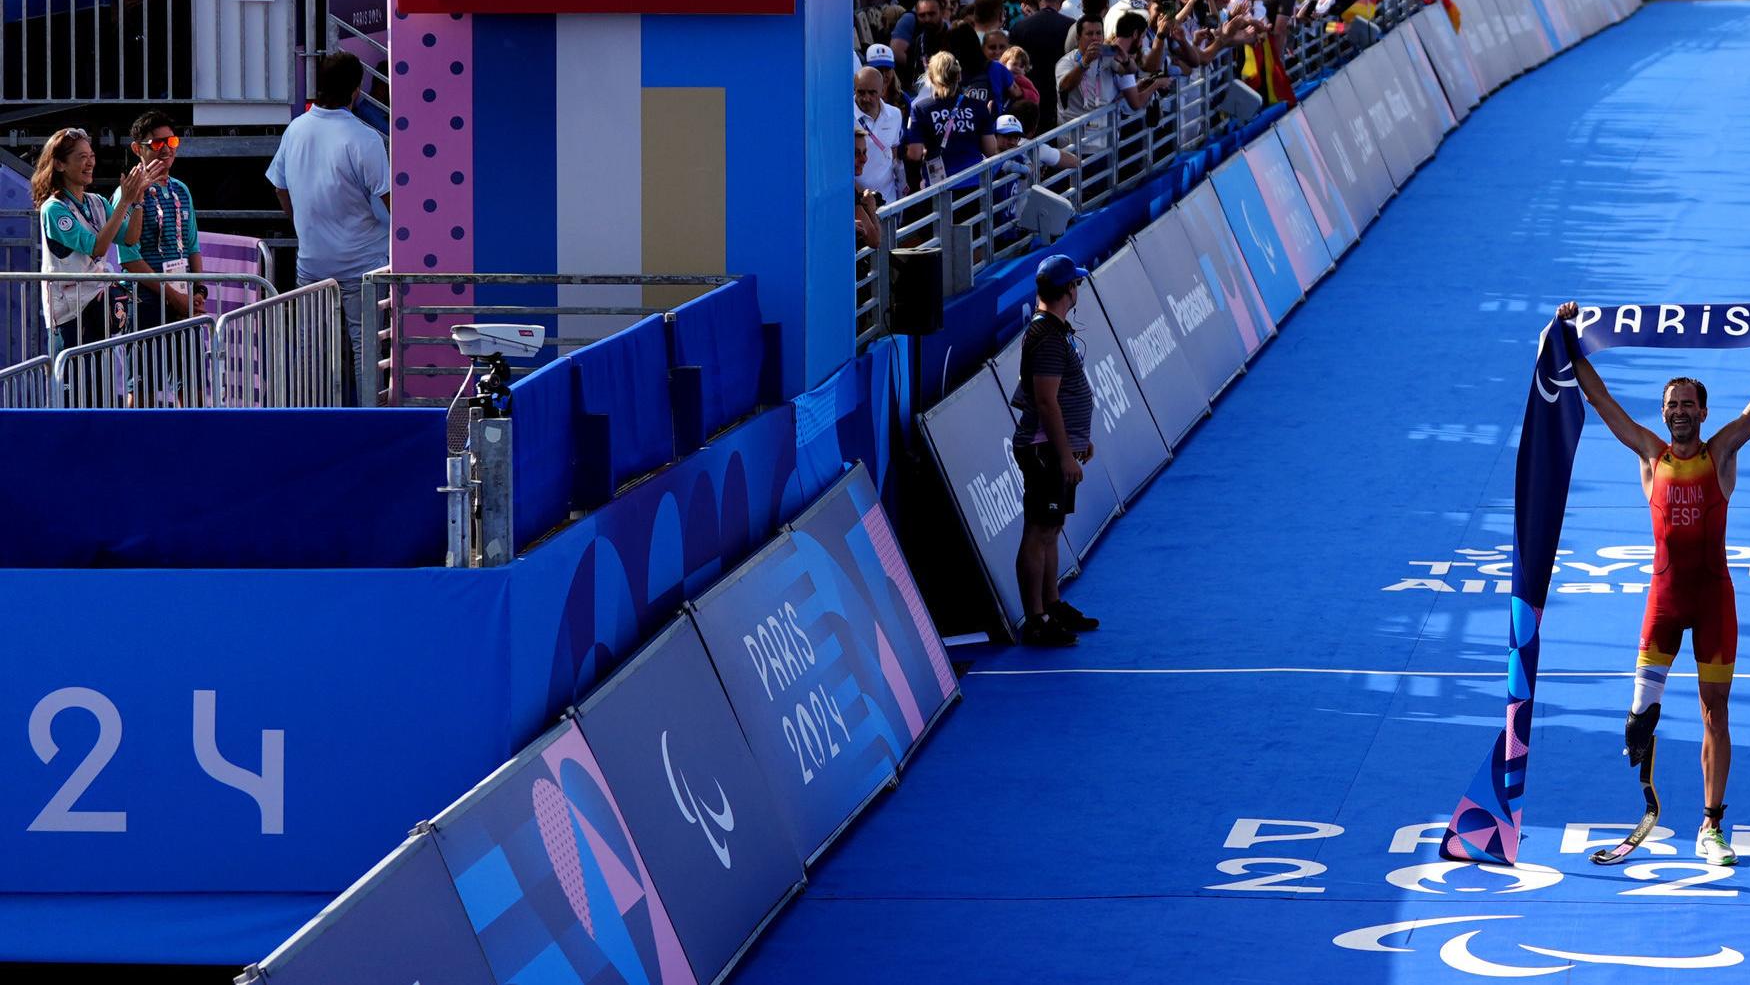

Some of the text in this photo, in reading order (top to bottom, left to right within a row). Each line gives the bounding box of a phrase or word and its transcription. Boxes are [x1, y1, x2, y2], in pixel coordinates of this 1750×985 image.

[1166, 274, 1215, 337] Panasonic
[966, 471, 1025, 544] Allianz
[1666, 485, 1704, 504] MOLINA
[1671, 508, 1701, 526] ESP
[782, 683, 851, 785] 2024
